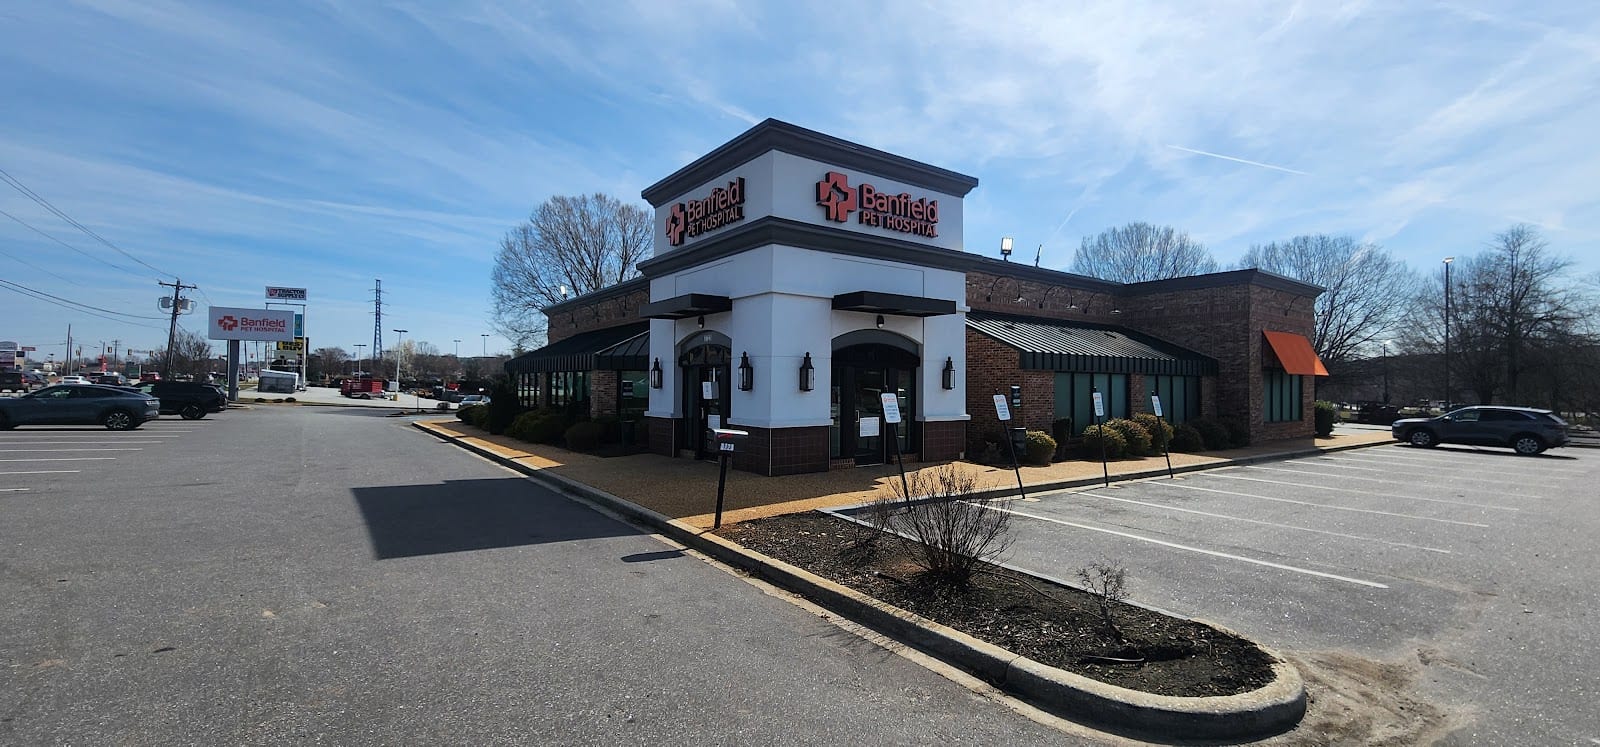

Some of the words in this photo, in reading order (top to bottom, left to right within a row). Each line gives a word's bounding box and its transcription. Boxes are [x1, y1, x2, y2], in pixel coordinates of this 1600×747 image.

[687, 177, 744, 222] Banfield
[861, 183, 938, 223] Banfield
[687, 220, 701, 237] PET
[701, 207, 743, 232] HOSPITAL
[860, 210, 884, 227] PET
[885, 215, 938, 237] HOSPITAL
[241, 317, 285, 327] Banfield
